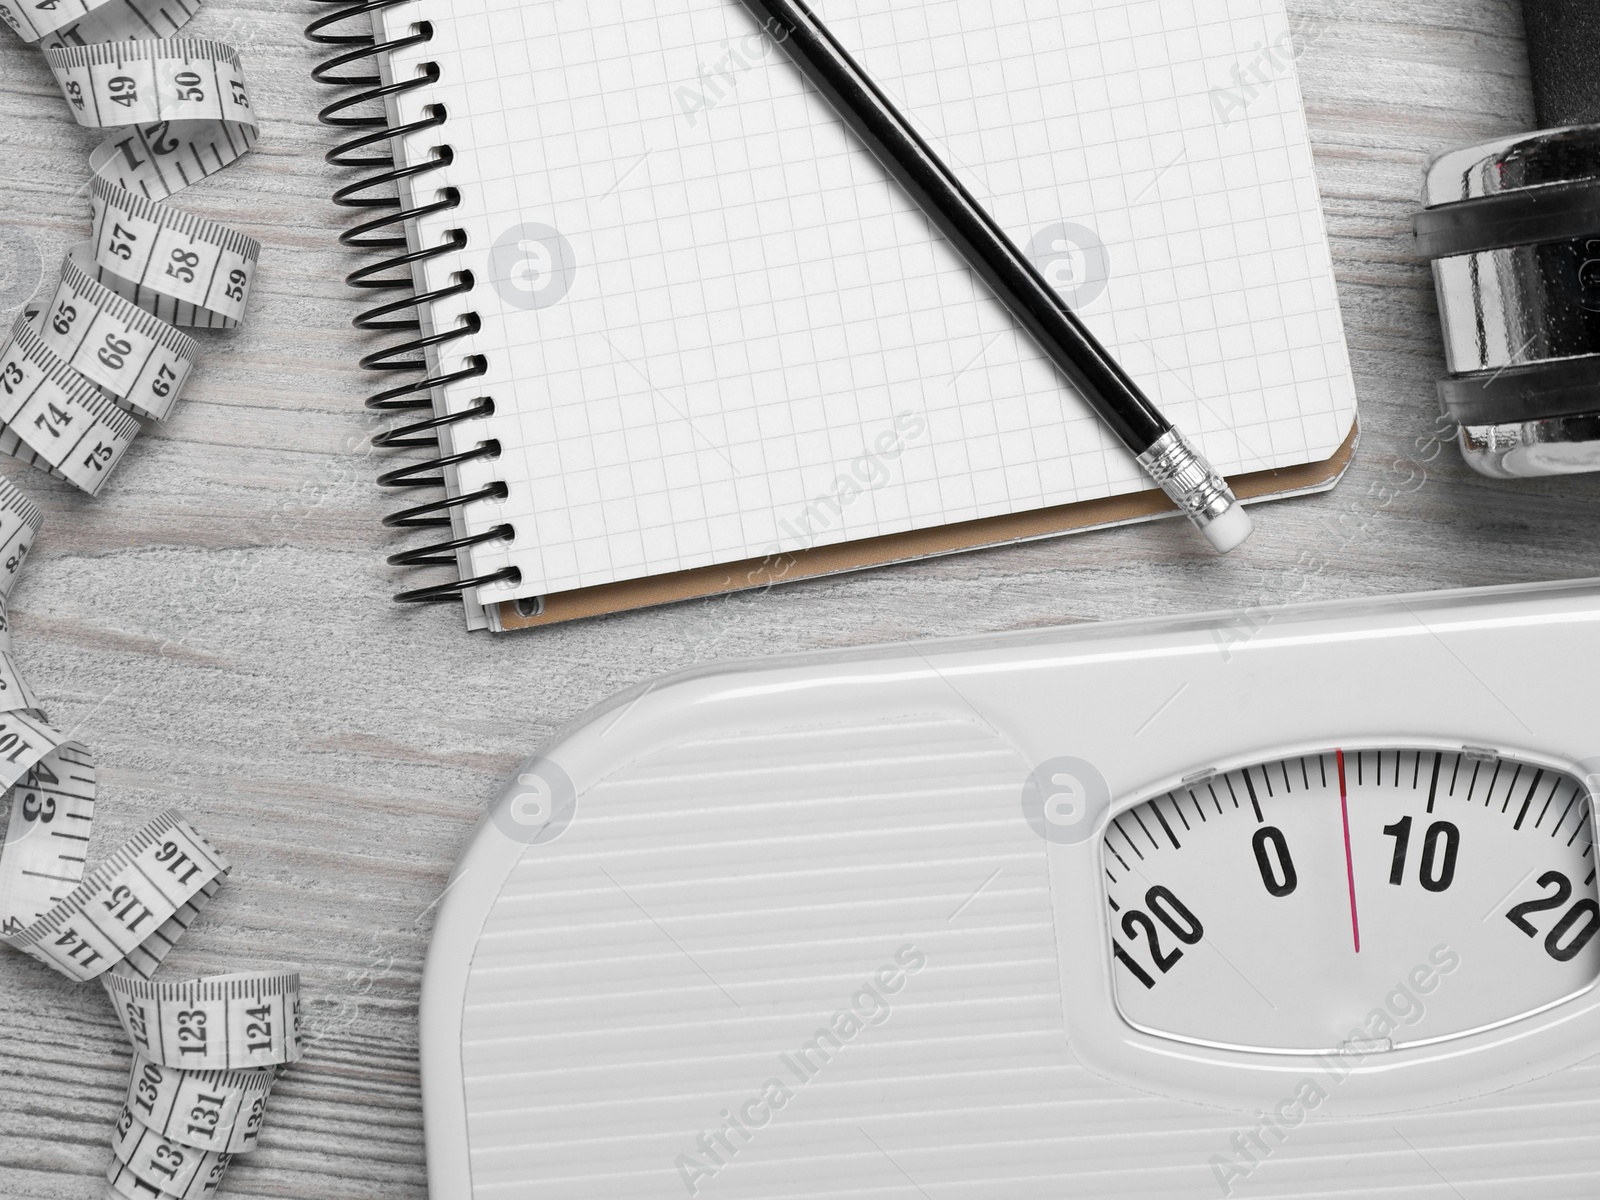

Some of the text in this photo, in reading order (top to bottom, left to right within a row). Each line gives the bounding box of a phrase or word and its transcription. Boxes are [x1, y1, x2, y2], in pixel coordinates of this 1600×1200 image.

[65, 79, 85, 112] 48
[107, 75, 138, 108] 49
[174, 71, 205, 103] 50
[229, 78, 250, 110] 51
[108, 223, 138, 261] 57
[165, 247, 200, 284] 58
[224, 268, 247, 303] 59
[52, 300, 77, 336] 65
[97, 332, 133, 371] 66
[0, 361, 24, 395] 73
[151, 363, 178, 398] 67
[33, 402, 74, 439] 74
[82, 440, 114, 473] 75
[154, 840, 203, 887] 116
[1251, 825, 1298, 898] 0
[1383, 815, 1461, 890] 10
[101, 885, 155, 933] 115
[1505, 870, 1600, 962] 20
[54, 926, 104, 970] 114
[1113, 885, 1204, 990] 120
[126, 1001, 150, 1050] 122
[177, 1009, 208, 1058] 123
[246, 1003, 274, 1055] 124
[135, 1062, 165, 1117] 130
[186, 1091, 227, 1141] 131
[243, 1096, 268, 1144] 132
